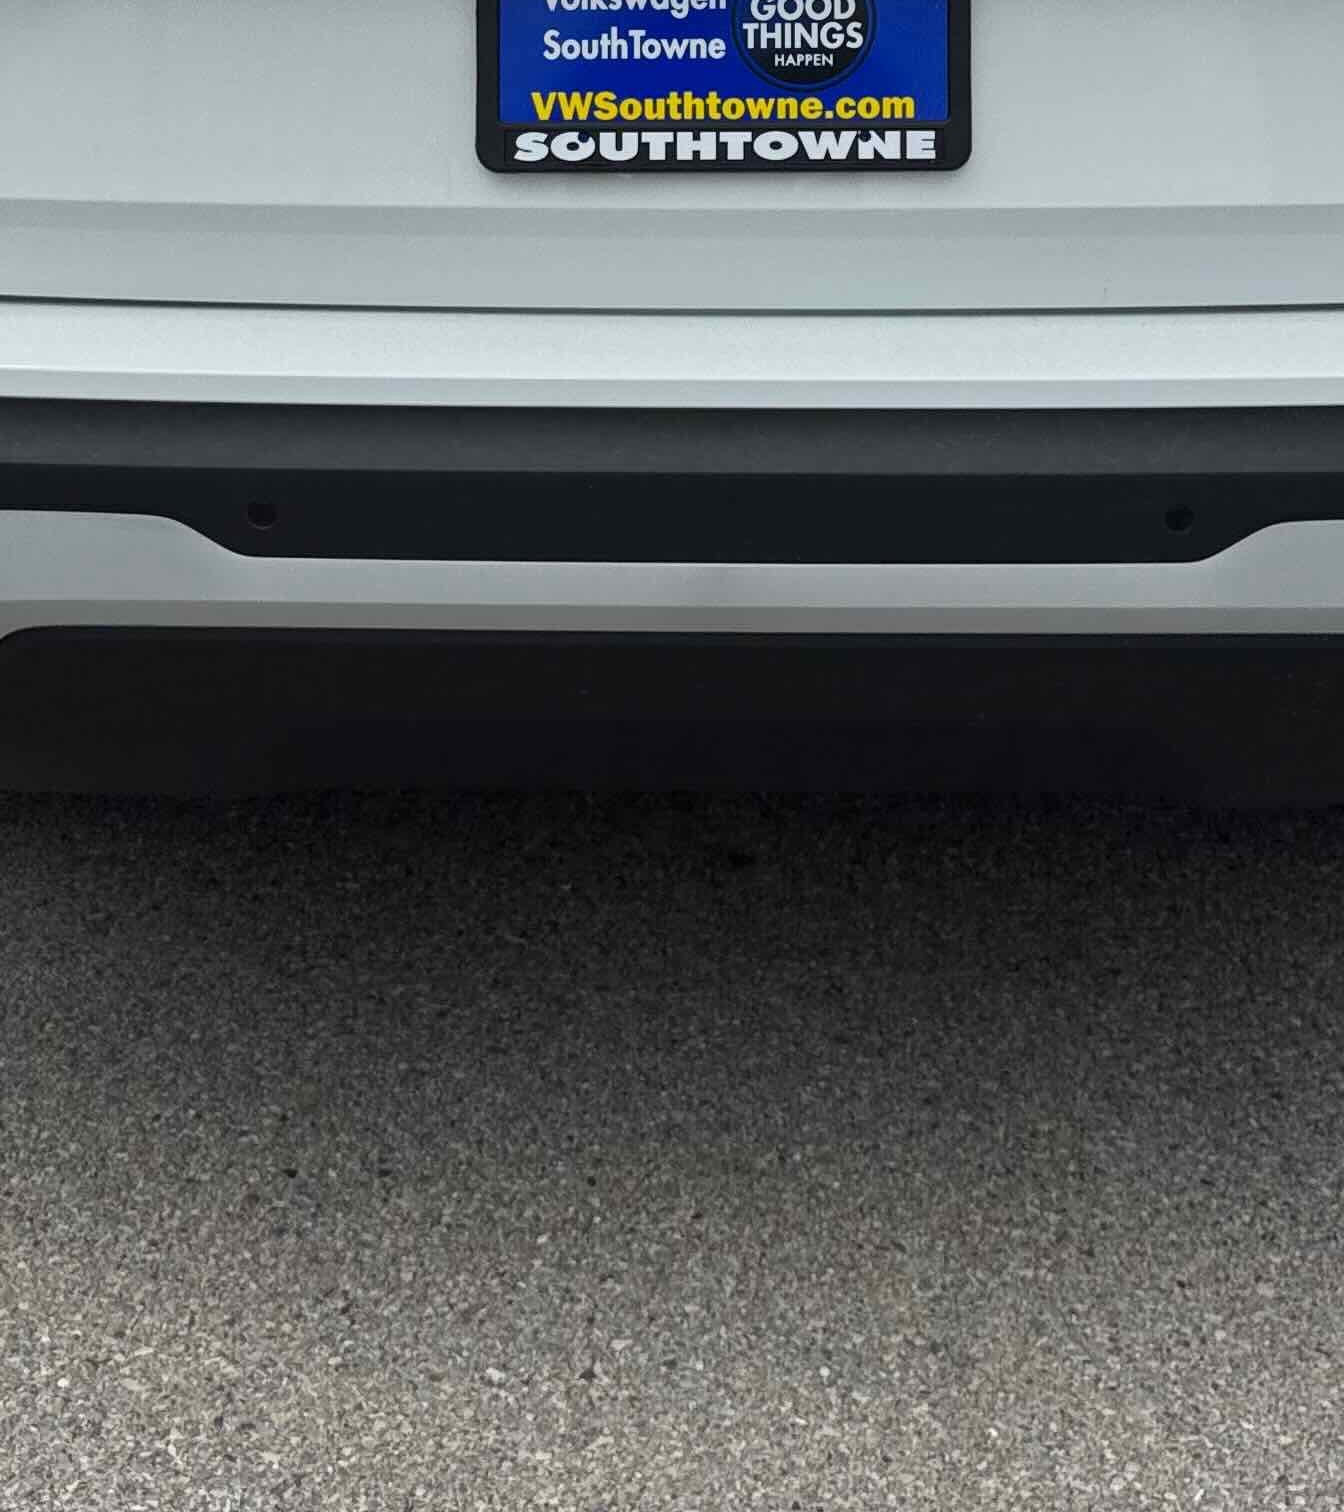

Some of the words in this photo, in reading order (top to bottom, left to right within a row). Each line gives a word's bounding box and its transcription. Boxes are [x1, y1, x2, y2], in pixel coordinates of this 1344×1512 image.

[543, 26, 726, 61] SouthTowne
[742, 22, 864, 50] THINGS
[774, 54, 834, 68] HAPPEN
[531, 90, 915, 122] VWSouthtowne.com
[513, 130, 937, 163] SOUTHTOWNE
